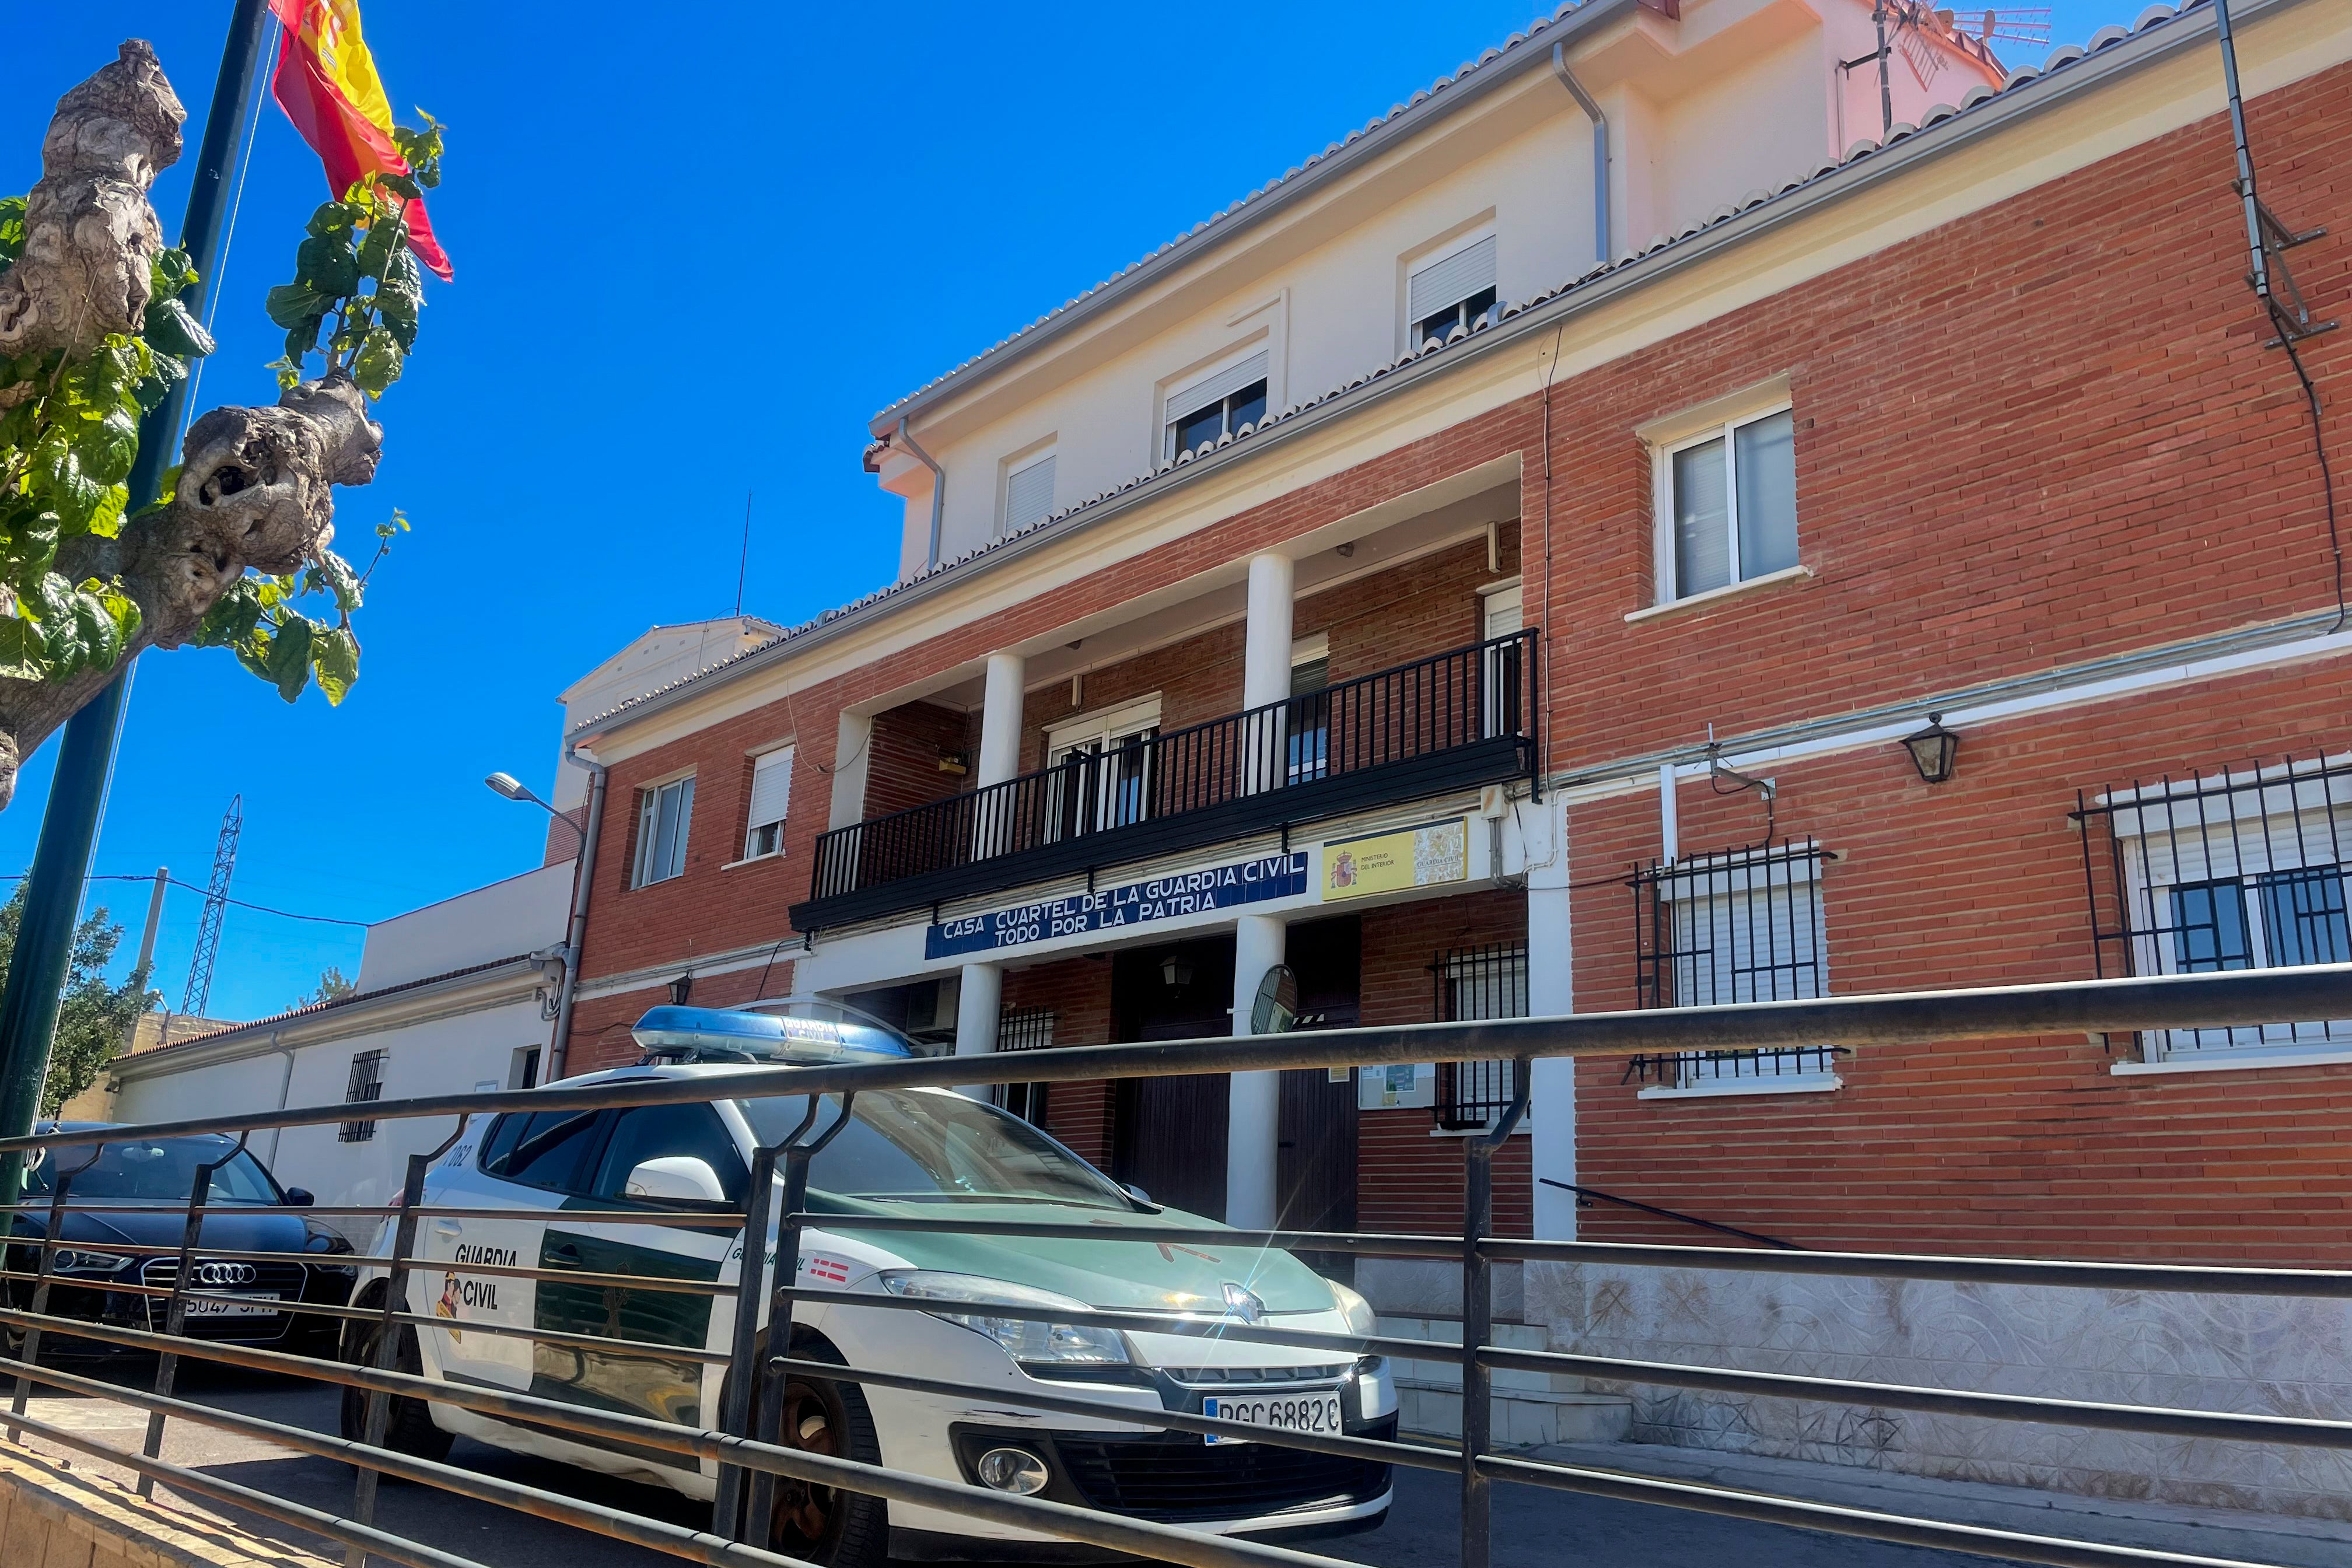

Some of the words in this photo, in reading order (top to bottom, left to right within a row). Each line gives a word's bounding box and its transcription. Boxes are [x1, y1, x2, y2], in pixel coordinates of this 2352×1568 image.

[1361, 853, 1388, 862] MINISTERIO
[1371, 860, 1394, 869] INTERIOR
[1417, 859, 1443, 867] GUARDIA
[944, 916, 985, 939] CASA
[996, 899, 1075, 929] CUARTEL
[1082, 891, 1107, 912] DE
[1114, 886, 1139, 906] LA
[1146, 867, 1236, 900] GUARDIA
[1244, 855, 1304, 882] CIVIL
[995, 924, 1040, 947] TODO
[1051, 916, 1087, 937] POR
[1100, 908, 1125, 928] LA
[1139, 891, 1216, 921] PATRIA
[456, 1244, 517, 1266] GUARDIA
[463, 1280, 498, 1310] CIVIL
